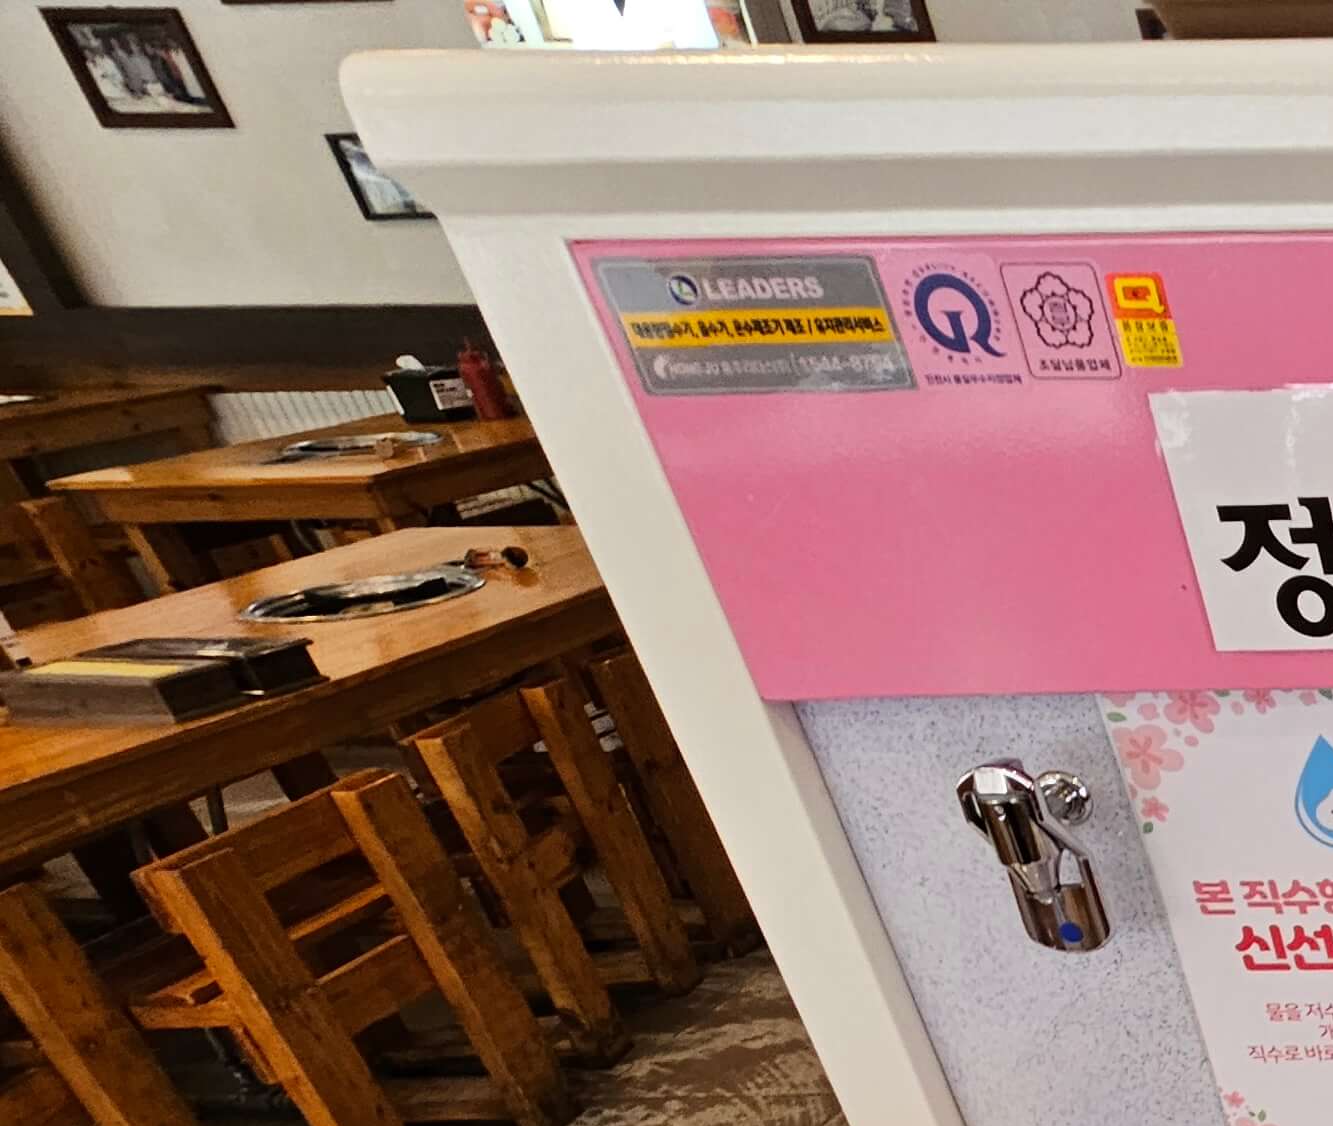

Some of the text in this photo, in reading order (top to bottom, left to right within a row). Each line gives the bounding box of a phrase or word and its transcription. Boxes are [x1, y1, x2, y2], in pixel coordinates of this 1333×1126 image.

[702, 276, 825, 301] LEADERS
[1193, 879, 1236, 915] 본
[1265, 1002, 1301, 1021] 물을
[1247, 1044, 1303, 1064] 직수로
